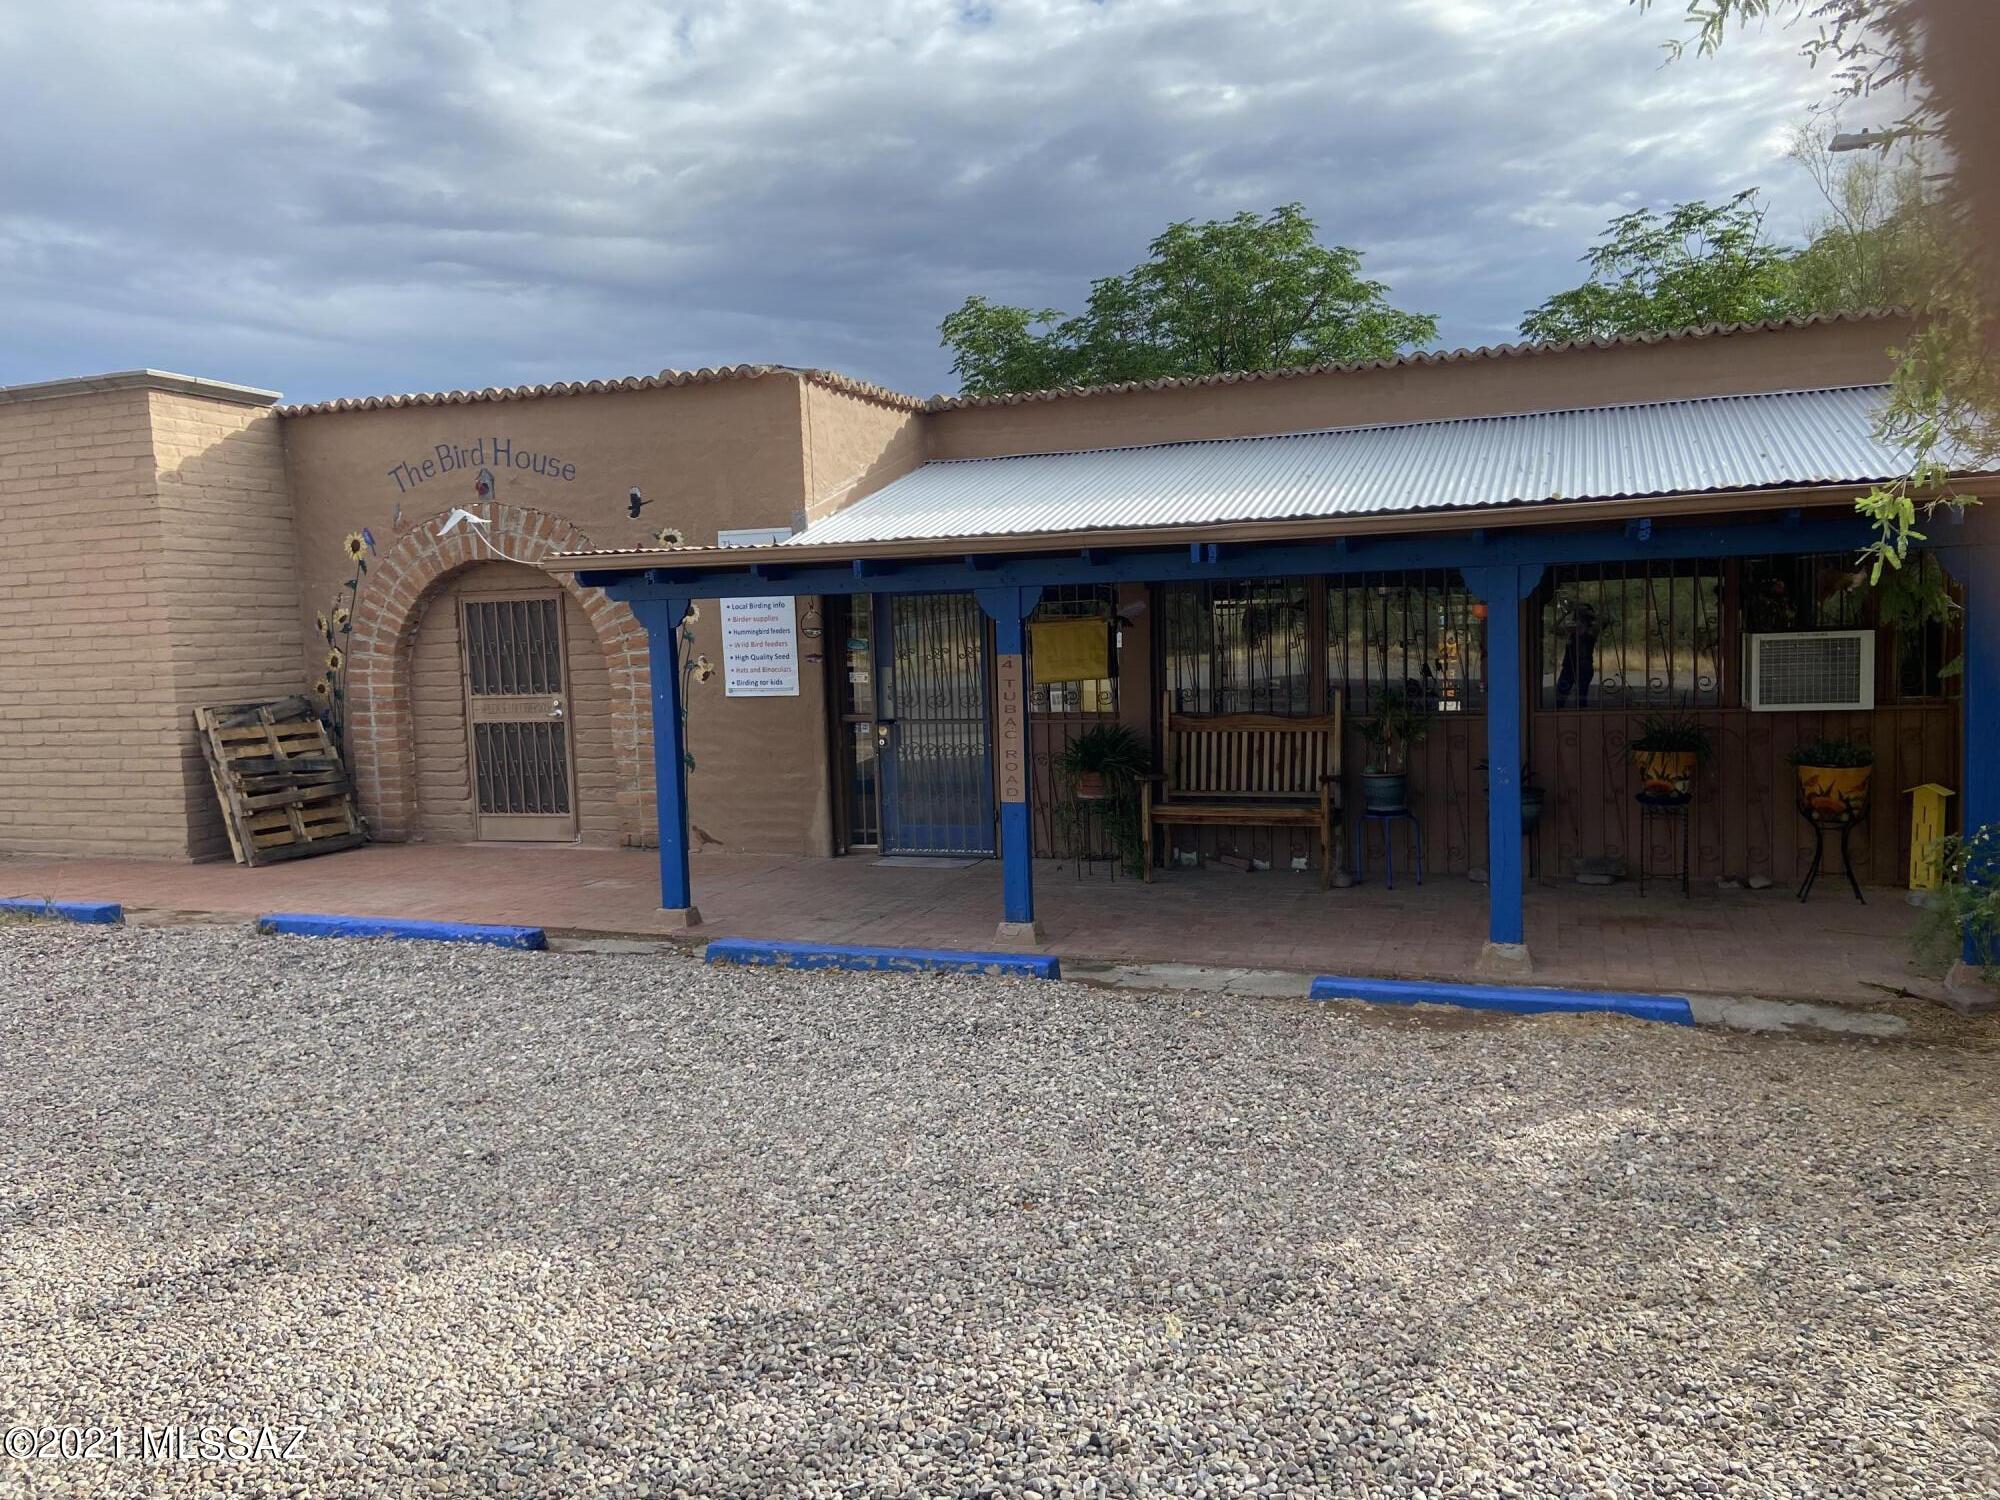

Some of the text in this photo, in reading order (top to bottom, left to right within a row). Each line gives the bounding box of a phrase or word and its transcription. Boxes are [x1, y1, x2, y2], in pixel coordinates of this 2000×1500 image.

[387, 437, 577, 493] The Bird House
[731, 601, 786, 611] Local Birding info
[752, 614, 779, 623] supplies
[733, 627, 791, 636] Hummingbird feeders
[750, 640, 764, 648] Bird
[735, 652, 790, 662] High Quality Seed
[762, 665, 792, 673] Binoculars
[736, 679, 759, 687] Birding
[770, 678, 784, 686] kids
[1003, 679, 1018, 739] TUBAC
[1005, 750, 1019, 797] ROAD
